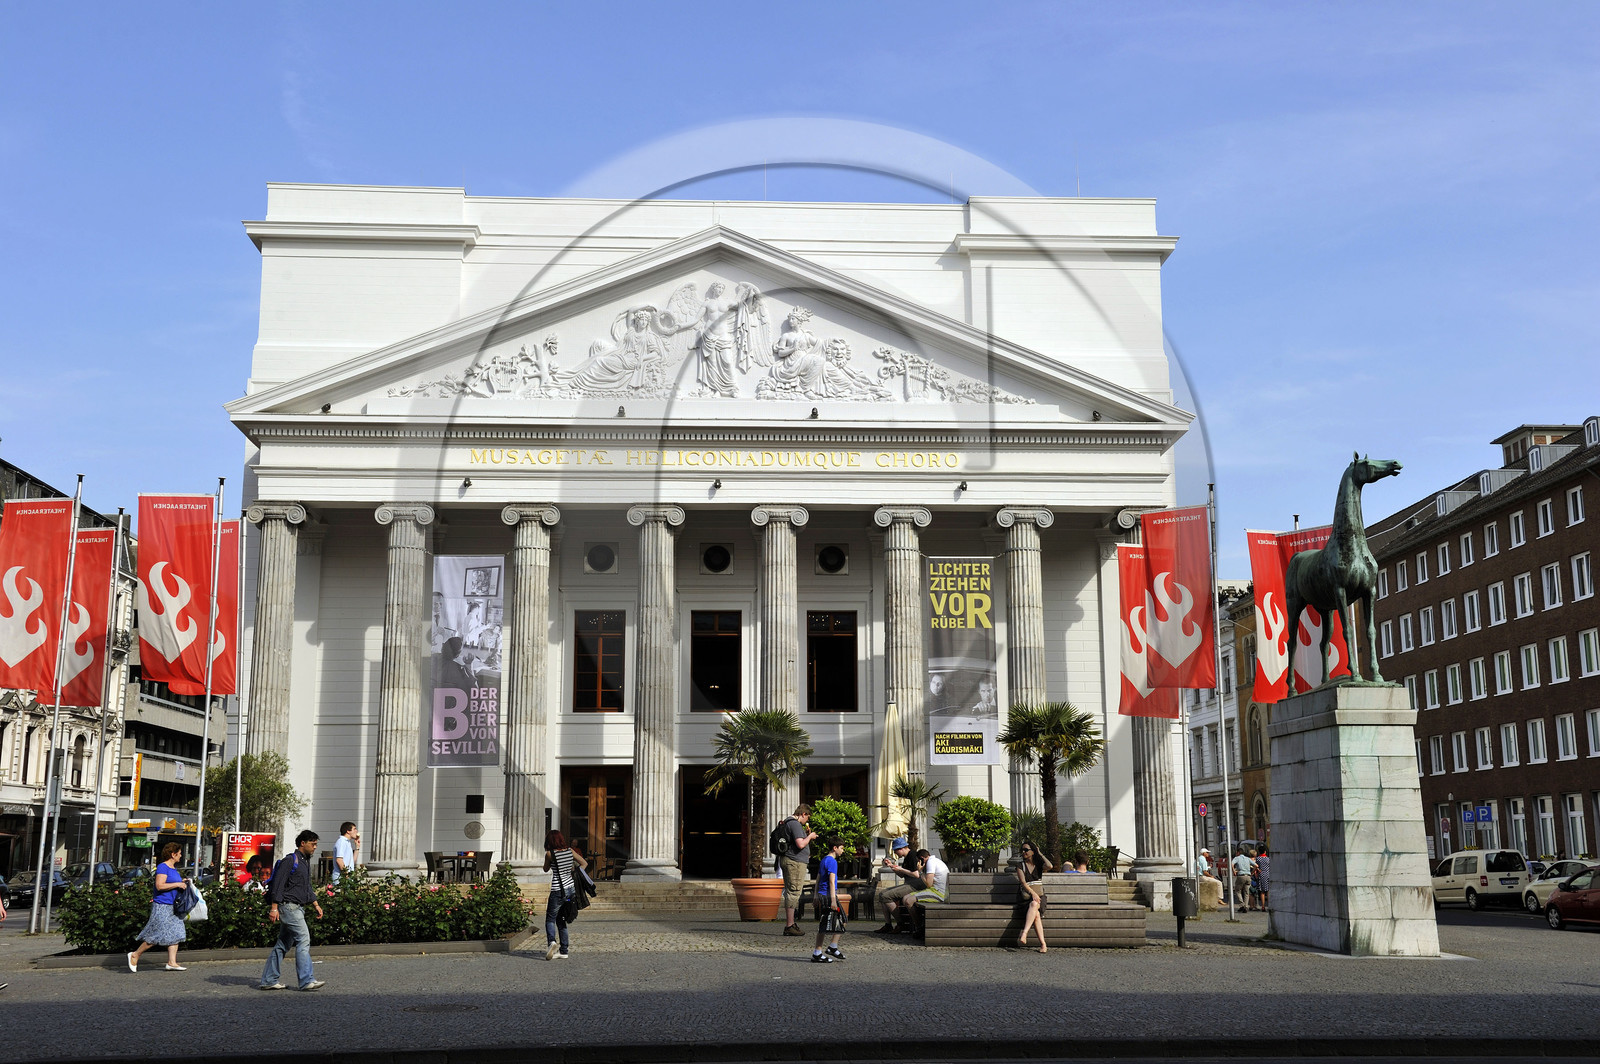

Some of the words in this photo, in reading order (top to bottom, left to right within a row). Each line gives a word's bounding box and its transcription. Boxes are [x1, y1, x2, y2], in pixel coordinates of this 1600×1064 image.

[469, 448, 613, 465] MUSAGETÆ
[626, 450, 861, 469] HELICONIADUMQUE
[875, 452, 960, 468] CHORO
[929, 563, 990, 576] LICHTER
[930, 577, 991, 591] ZIEHEN
[470, 687, 498, 699] DER
[470, 700, 497, 712] BAR
[470, 713, 497, 727] IER
[469, 727, 497, 740] VON
[431, 741, 497, 755] SEVILLA
[935, 745, 983, 753] KAURISMÄKI
[1465, 812, 1473, 821] P
[1479, 808, 1489, 821] P
[229, 834, 252, 843] CHOR
